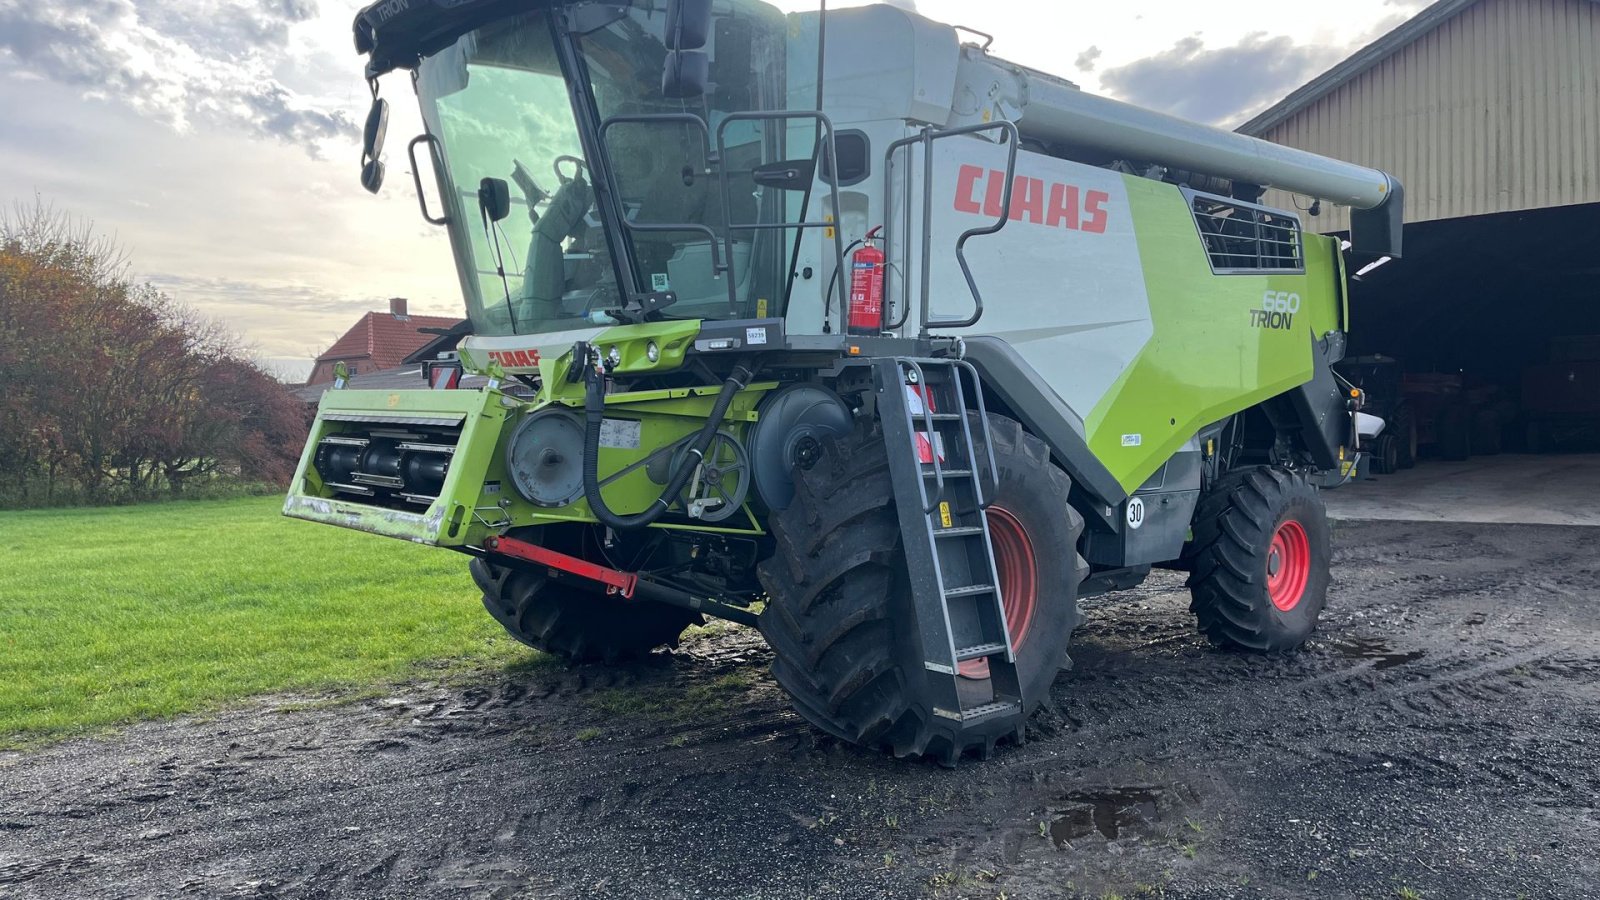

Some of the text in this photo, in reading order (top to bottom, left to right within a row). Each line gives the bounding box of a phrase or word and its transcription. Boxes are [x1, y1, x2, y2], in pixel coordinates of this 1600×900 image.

[376, 0, 409, 22] TRION
[954, 164, 1109, 234] CLAAS
[1263, 290, 1300, 314] 660
[1250, 309, 1293, 330] TRION
[1129, 503, 1142, 523] 30
